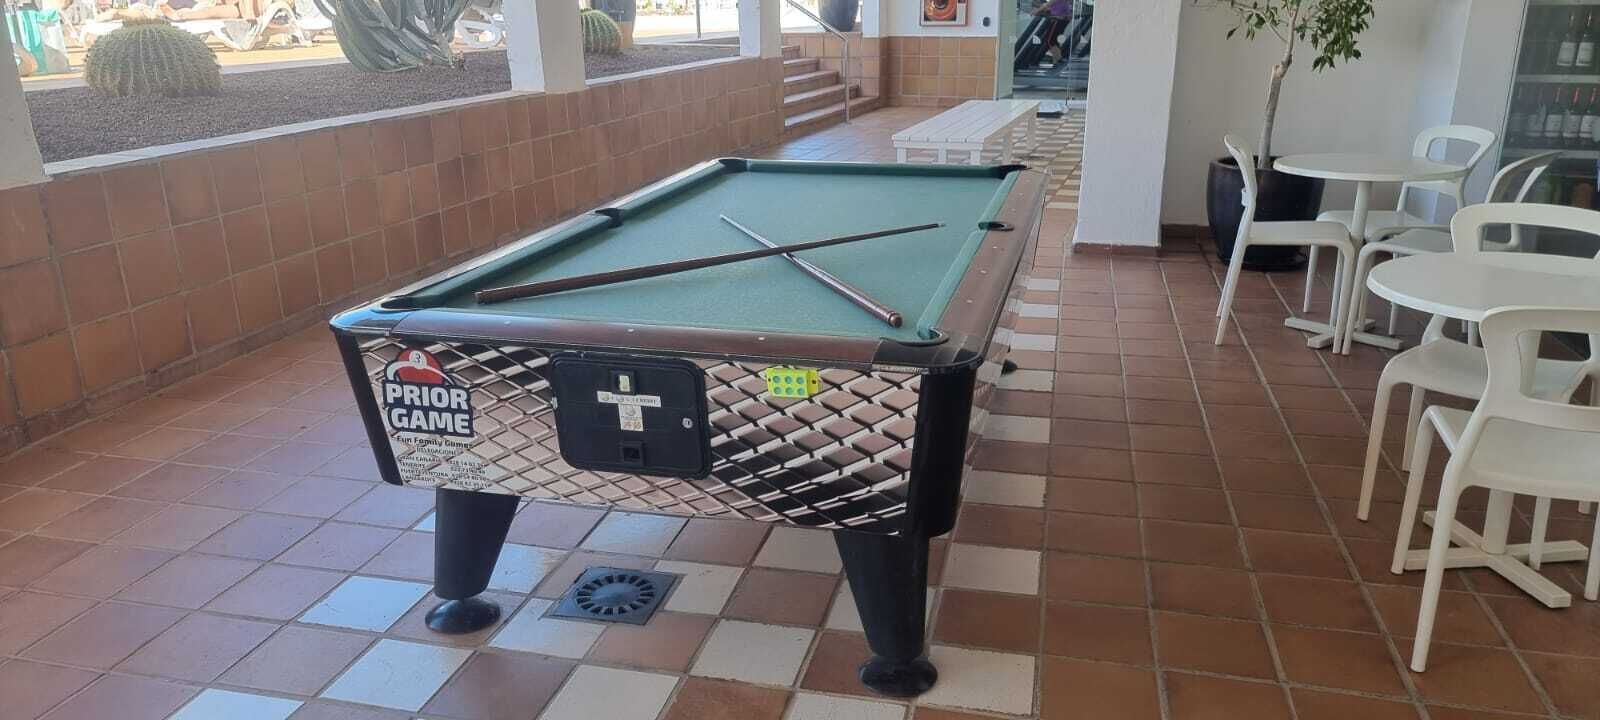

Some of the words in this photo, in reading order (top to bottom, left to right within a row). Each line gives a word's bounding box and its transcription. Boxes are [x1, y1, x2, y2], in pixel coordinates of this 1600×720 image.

[385, 383, 468, 410] PRIOR
[391, 408, 470, 434] GAME
[414, 437, 442, 447] Family
[445, 440, 474, 449] Games
